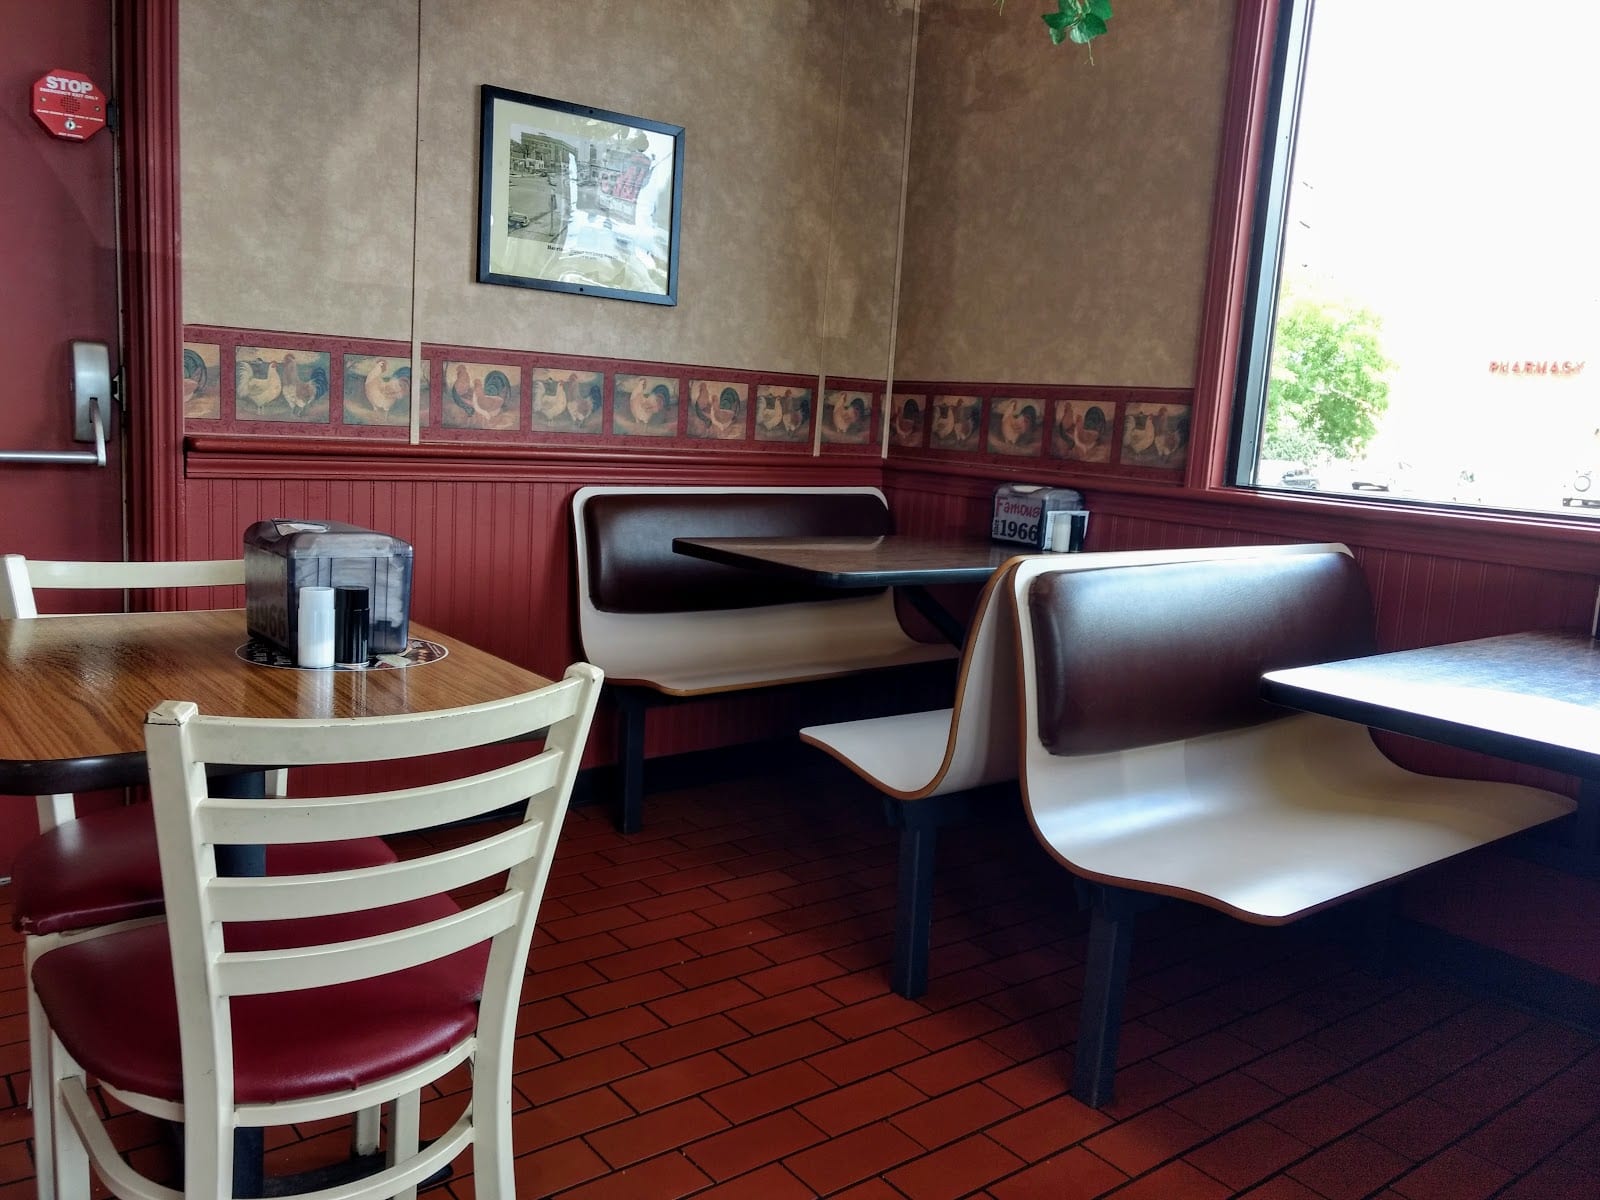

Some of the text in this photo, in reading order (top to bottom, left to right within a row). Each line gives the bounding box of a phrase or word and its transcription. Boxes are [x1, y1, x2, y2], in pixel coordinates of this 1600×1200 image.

[46, 75, 93, 94] STOP
[996, 495, 1041, 518] Famous
[1000, 519, 1039, 542] 1966
